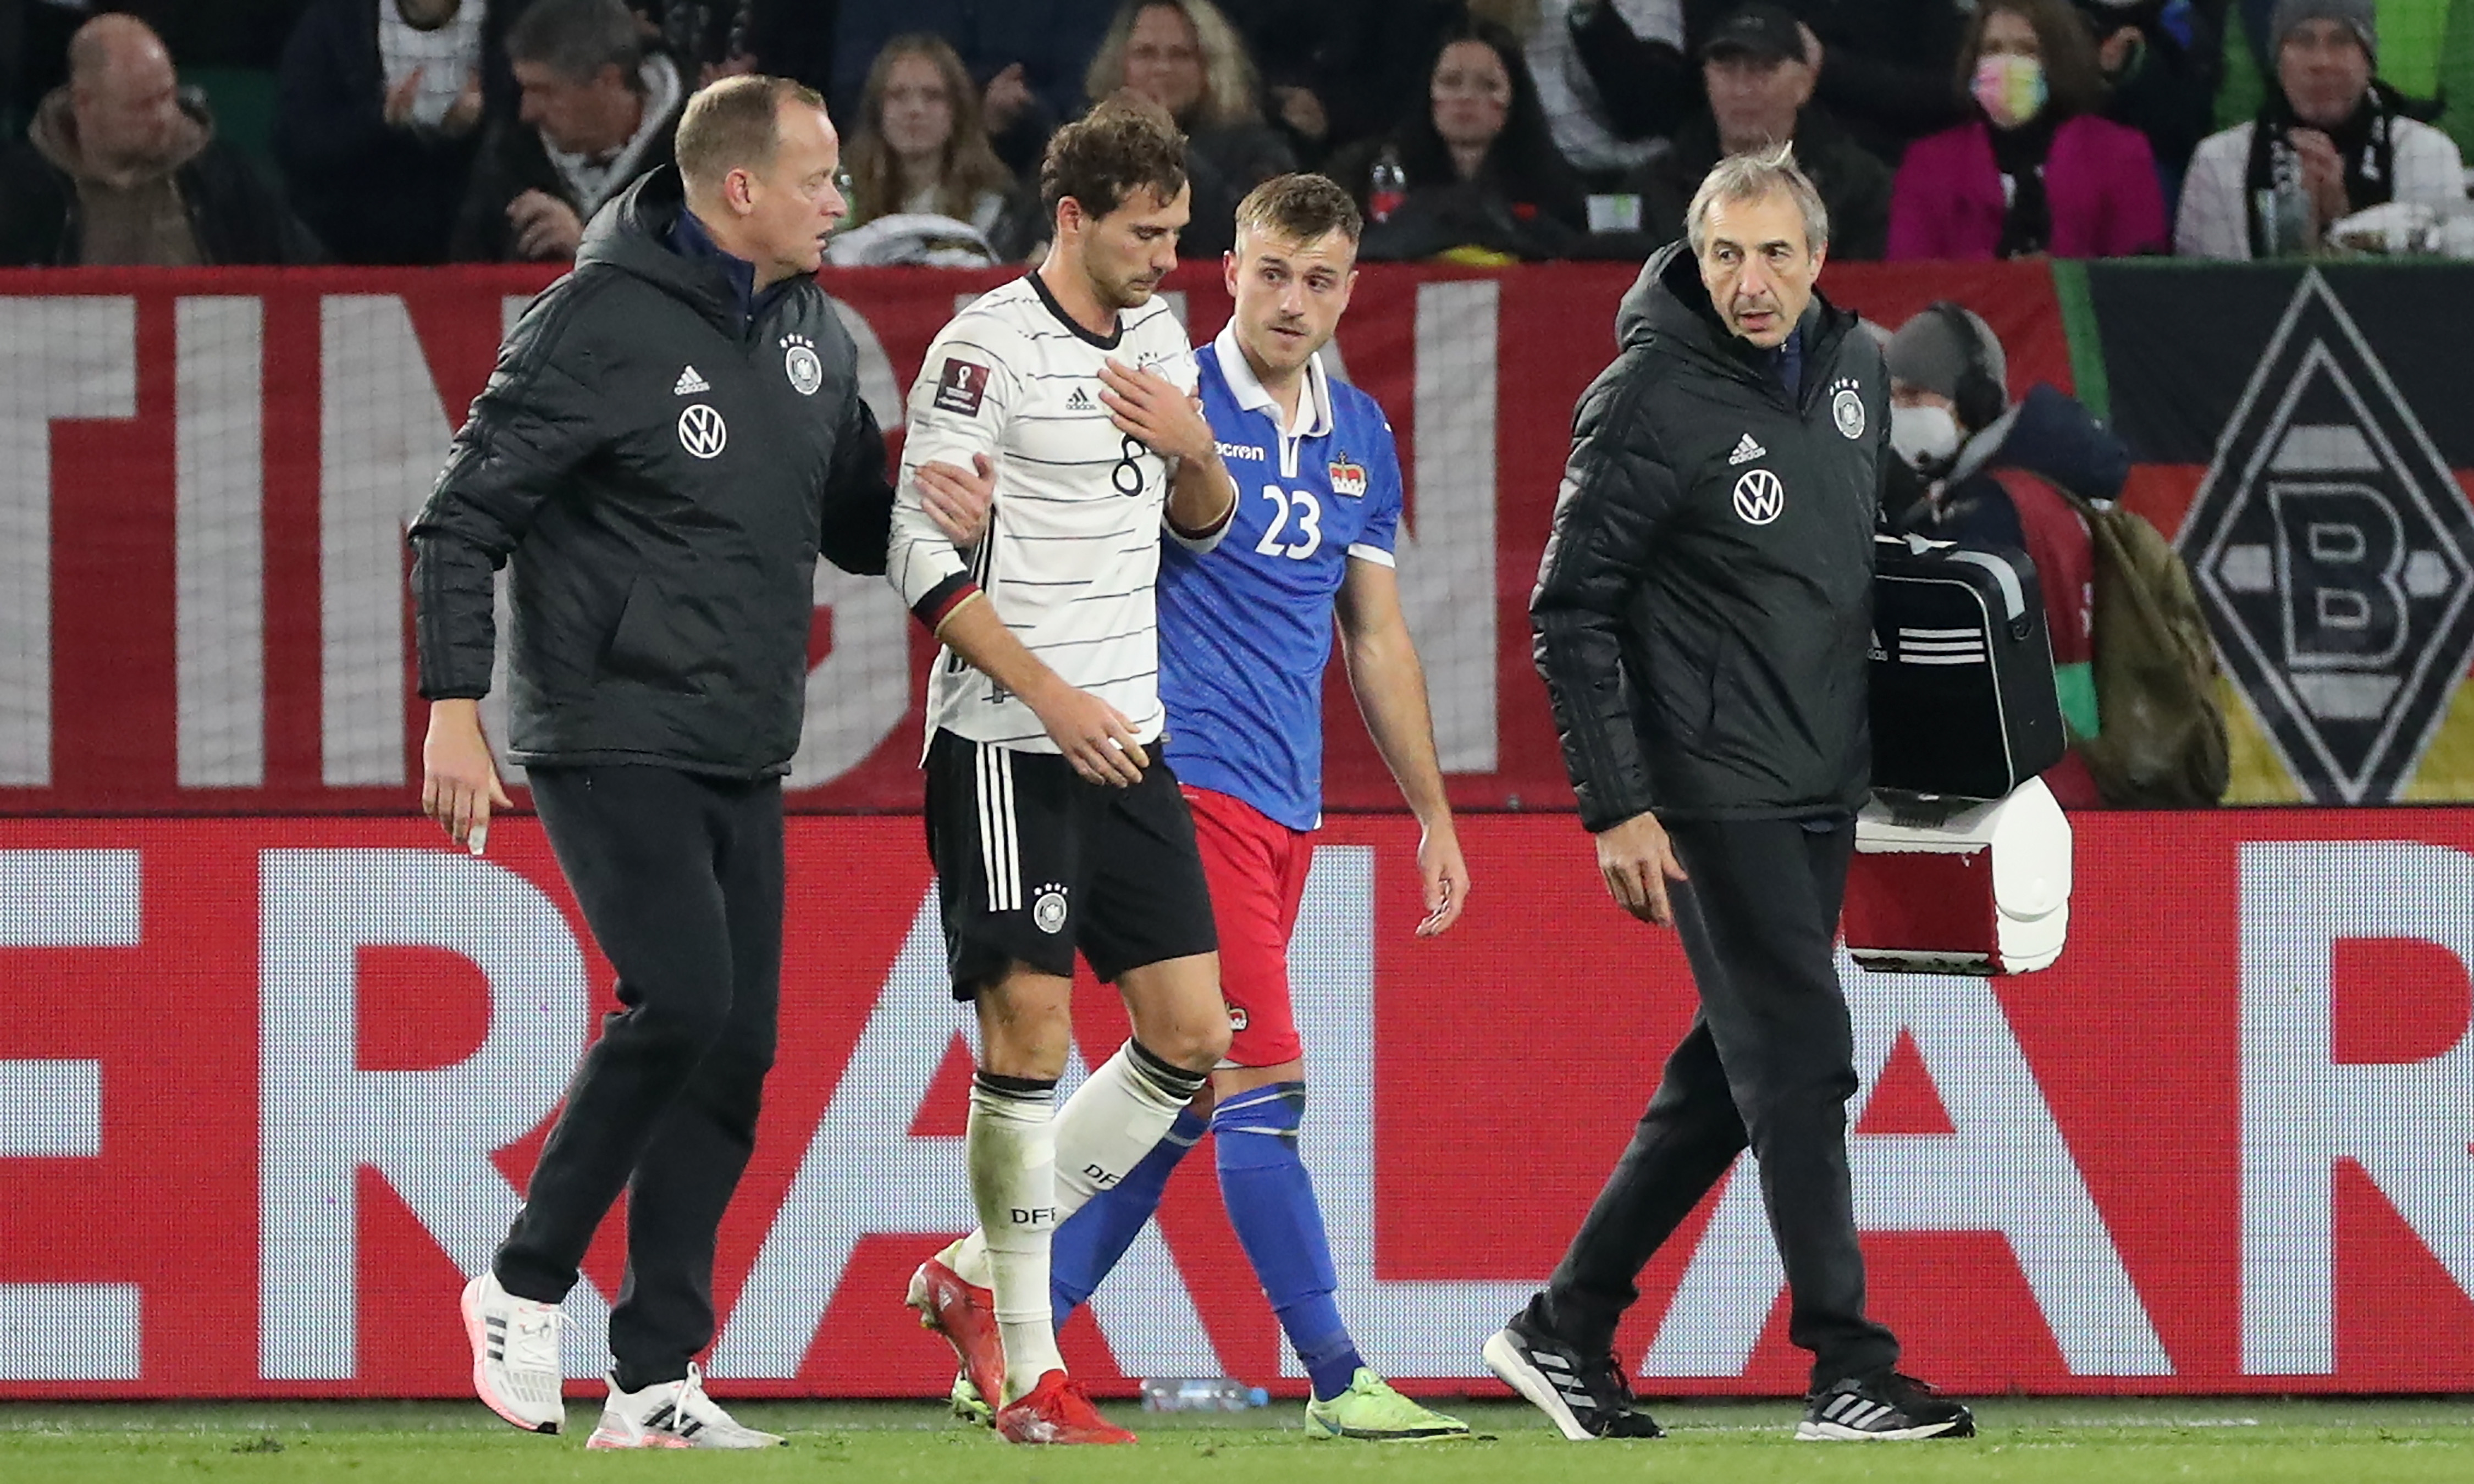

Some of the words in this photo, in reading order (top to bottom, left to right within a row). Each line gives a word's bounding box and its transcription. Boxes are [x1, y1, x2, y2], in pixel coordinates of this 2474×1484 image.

[1112, 433, 1146, 497] 8
[1729, 447, 1766, 465] adidas
[1255, 485, 1322, 561] 23
[2267, 481, 2408, 669] B
